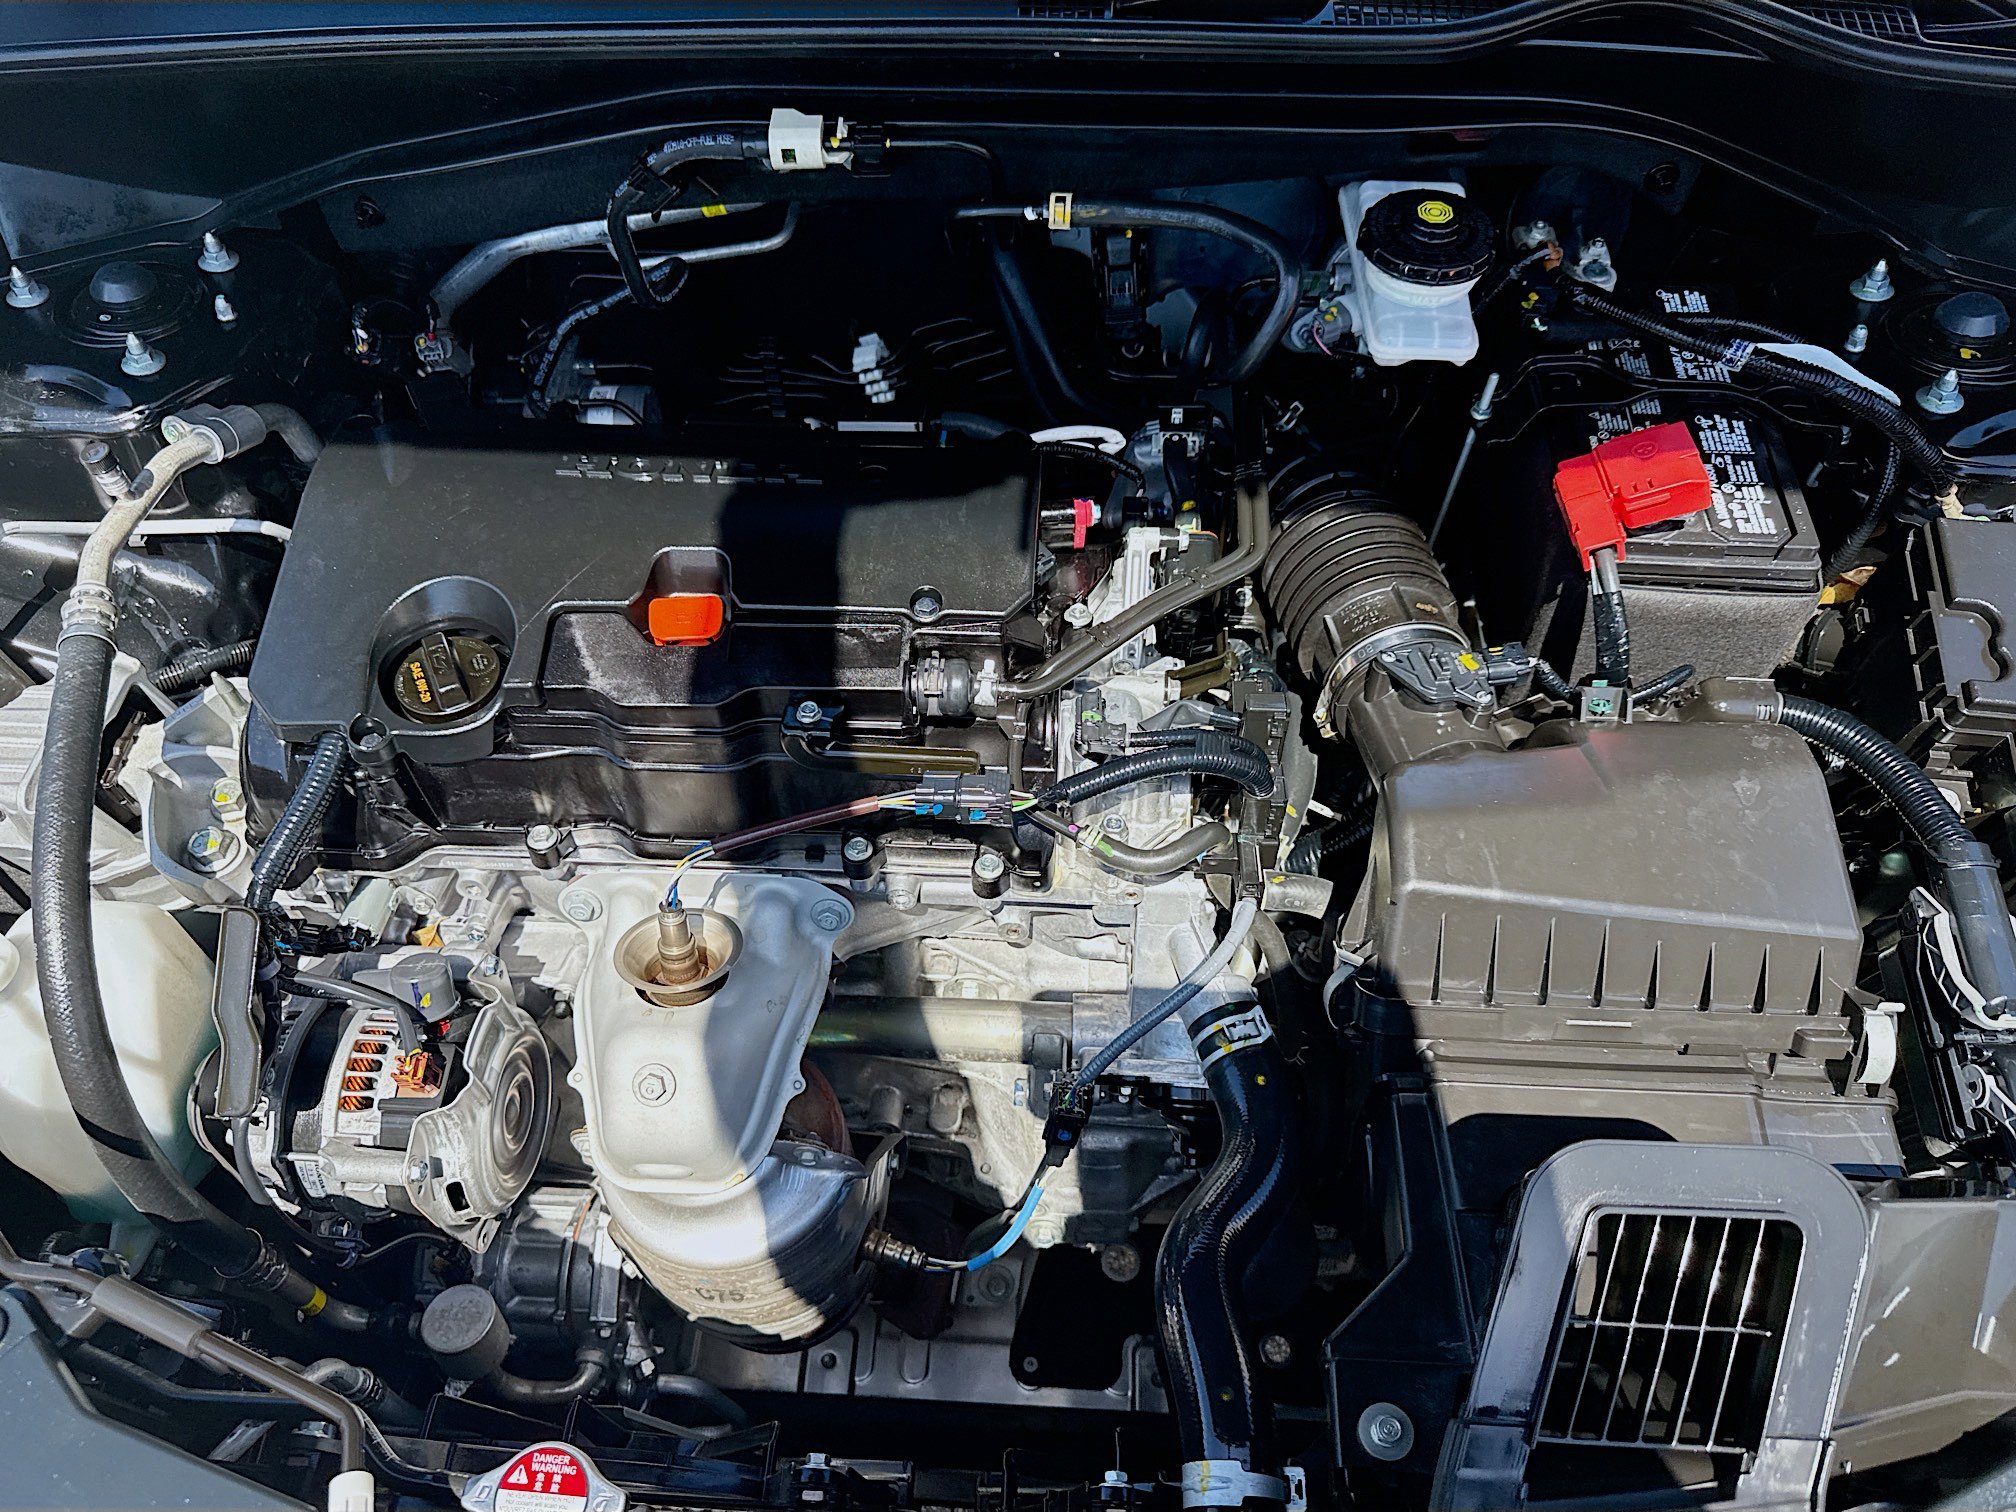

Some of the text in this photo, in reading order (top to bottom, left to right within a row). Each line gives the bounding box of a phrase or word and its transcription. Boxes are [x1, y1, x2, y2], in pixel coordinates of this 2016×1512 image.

[409, 661, 432, 703] SAE 0W-20
[533, 1453, 570, 1464] DANGER
[531, 1462, 578, 1475] WARNUNG
